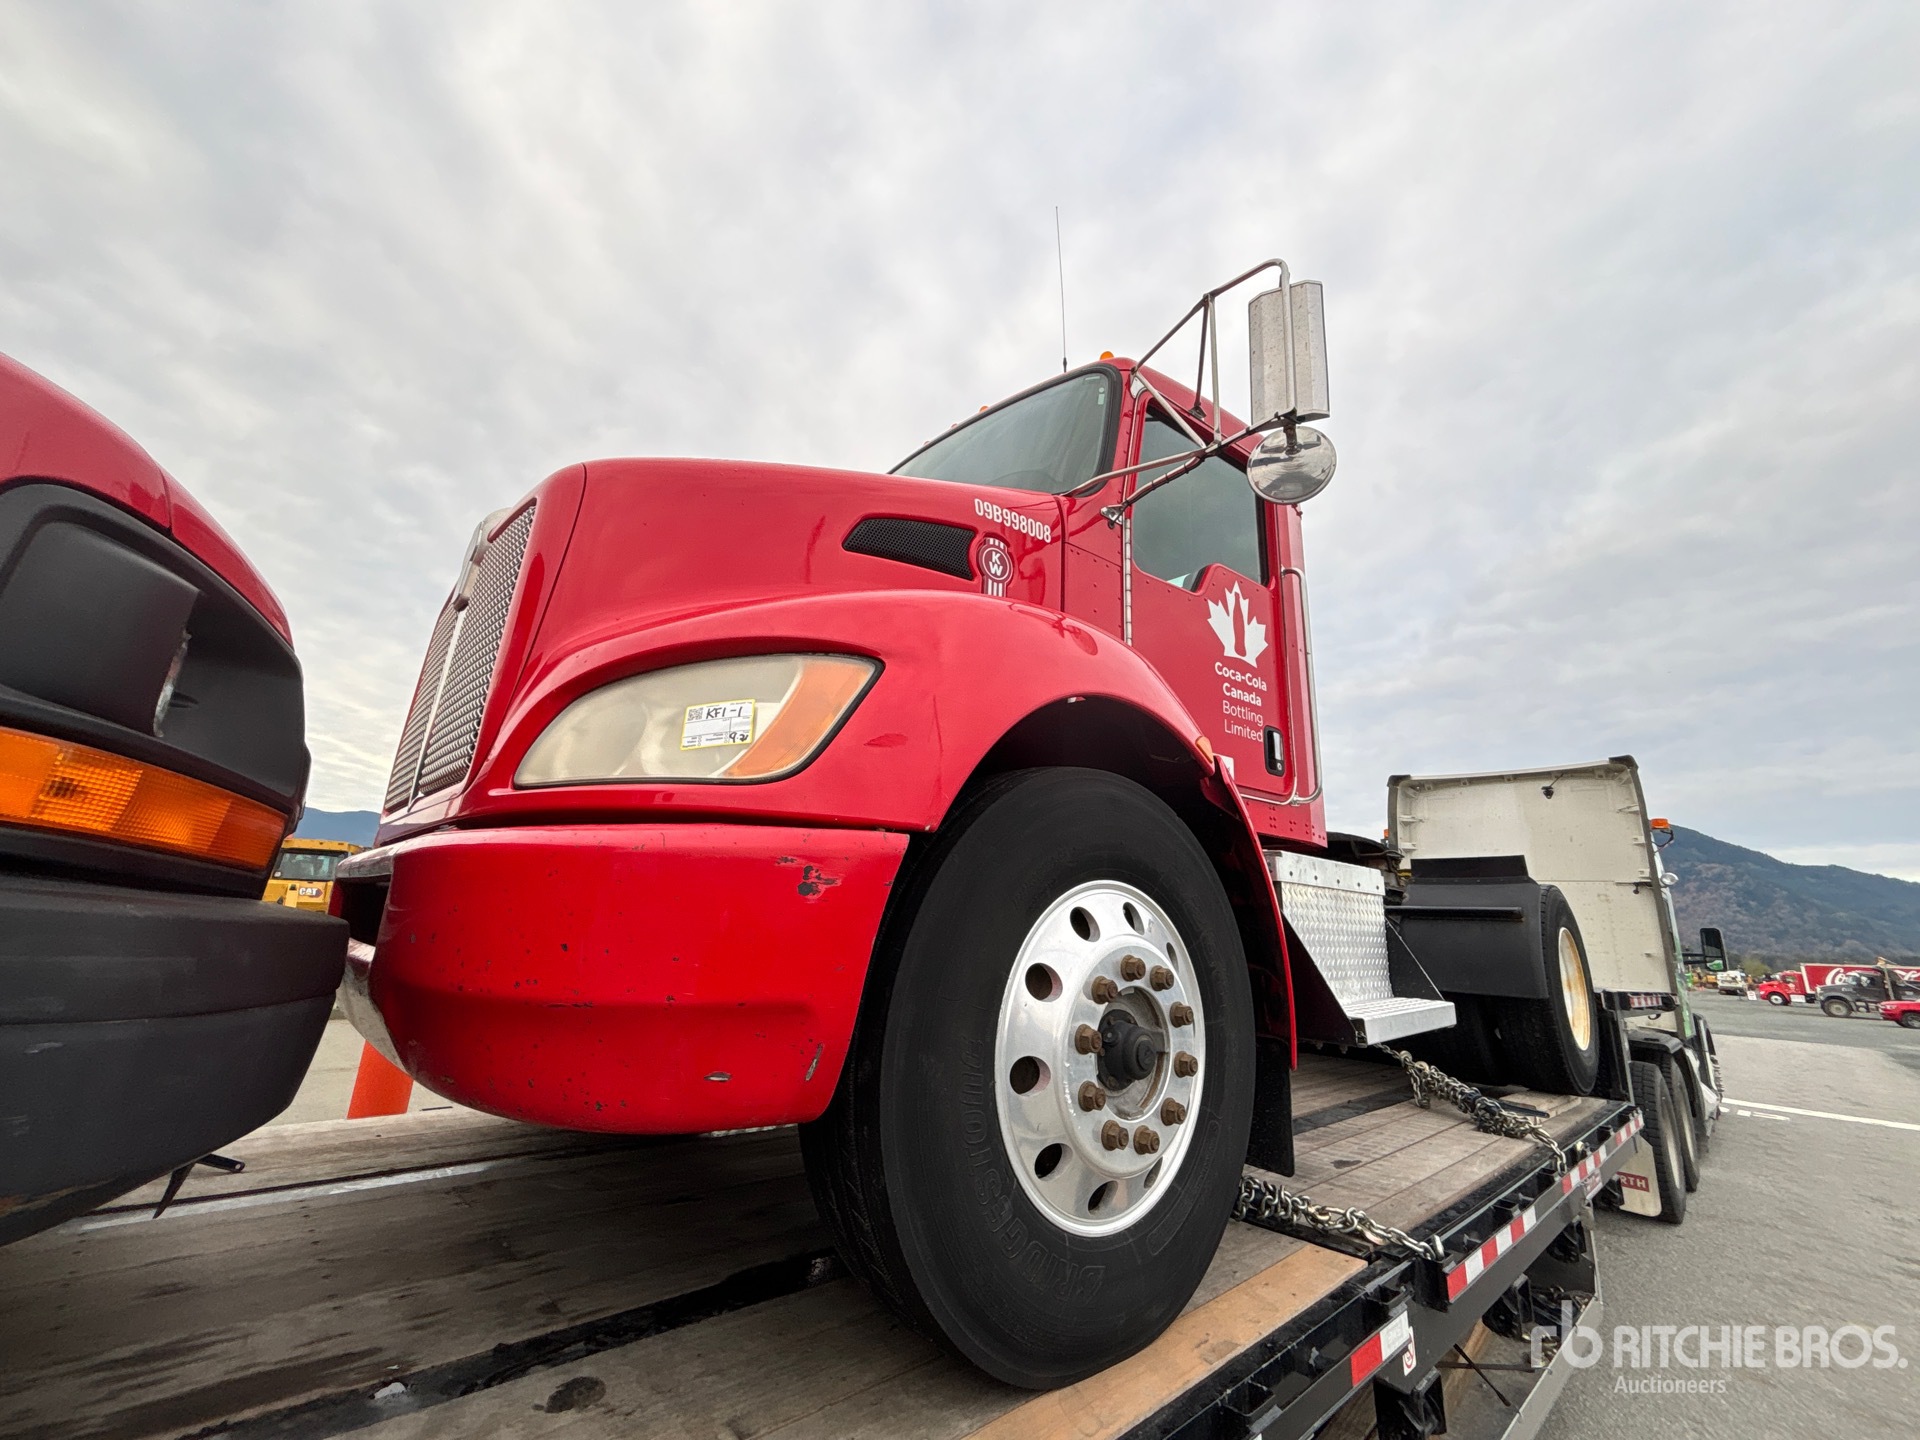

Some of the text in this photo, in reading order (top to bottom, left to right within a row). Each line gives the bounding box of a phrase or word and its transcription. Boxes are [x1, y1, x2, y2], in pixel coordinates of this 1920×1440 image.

[974, 498, 1052, 543] 09B998008
[989, 561, 1003, 576] W
[991, 551, 1001, 565] K
[1214, 661, 1267, 692] Coca-Cola
[1222, 682, 1262, 707] Canada
[1222, 700, 1263, 727] Bottling
[1224, 719, 1264, 743] Limited
[299, 887, 318, 896] CAT
[1620, 1175, 1647, 1189] RTH
